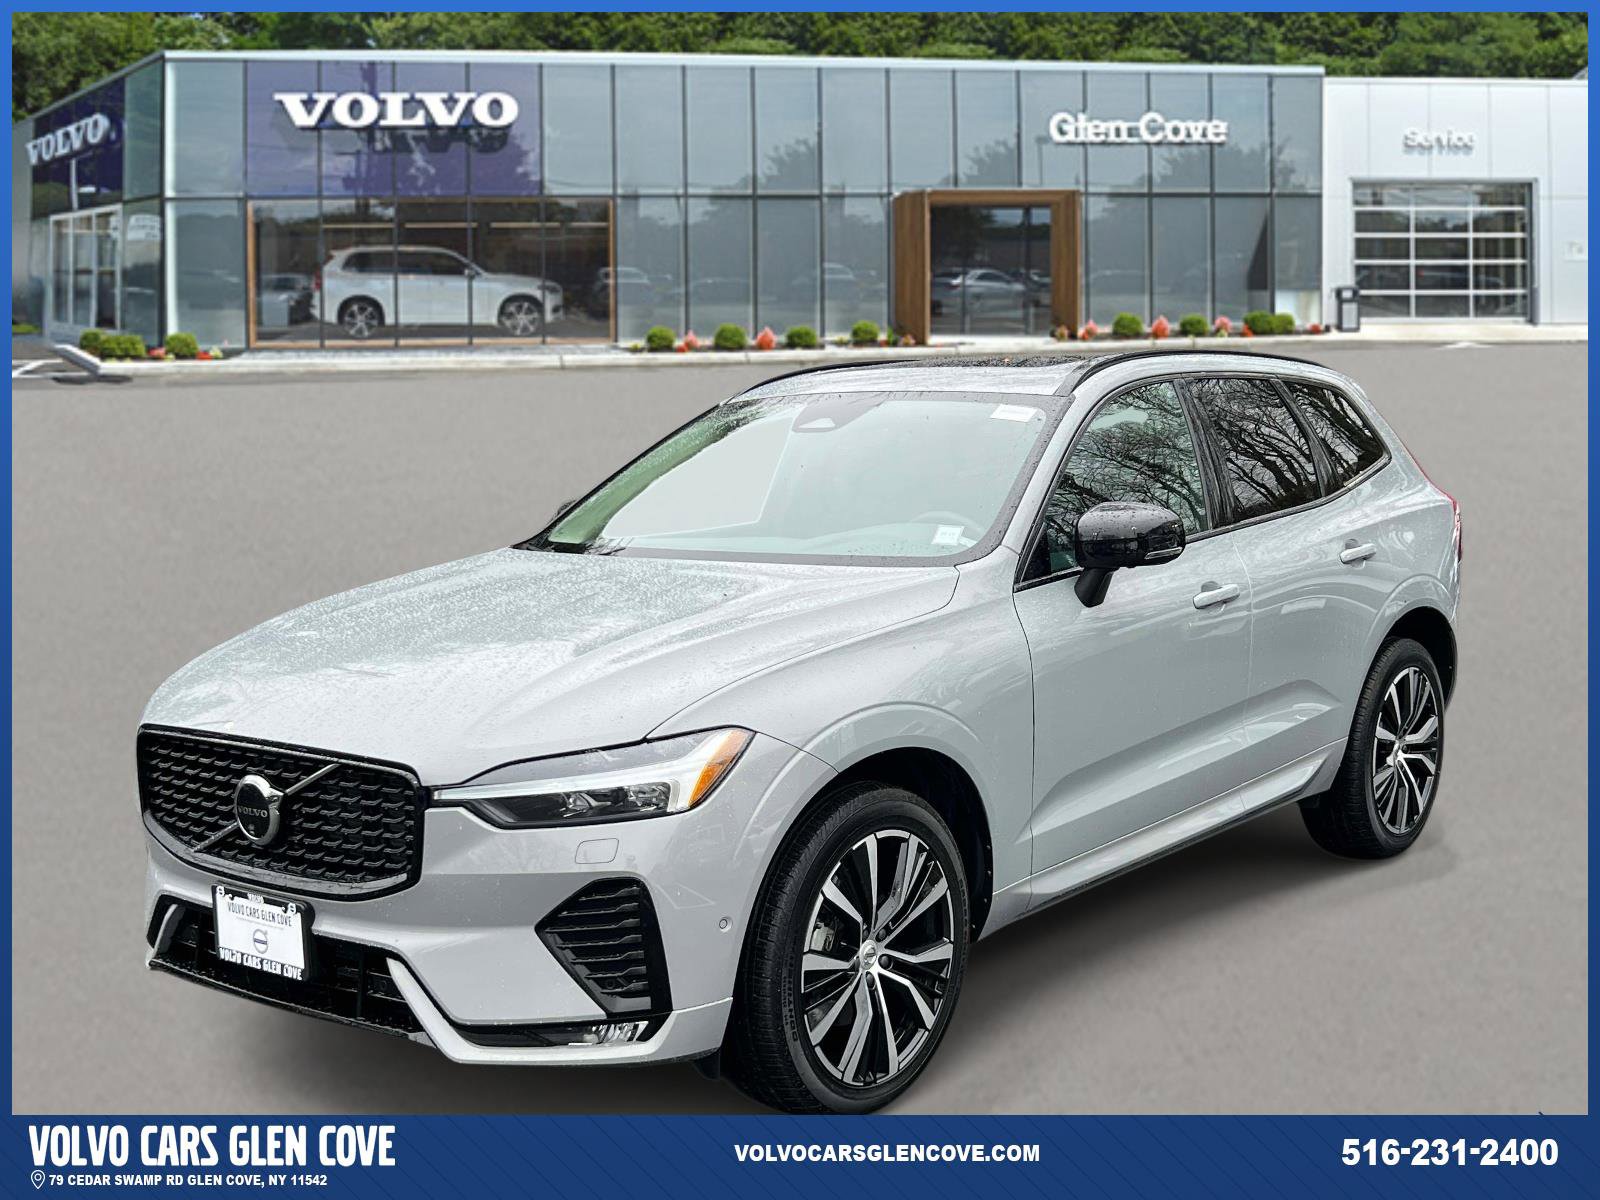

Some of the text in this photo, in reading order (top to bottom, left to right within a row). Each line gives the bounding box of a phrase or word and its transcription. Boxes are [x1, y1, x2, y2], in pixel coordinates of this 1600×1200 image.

[275, 92, 519, 128] VOLVO
[25, 112, 111, 166] VOLVO
[1050, 112, 1228, 143] Glen Cove
[1403, 128, 1475, 155] Service
[240, 805, 268, 818] VOLVO
[245, 905, 260, 919] CARS
[261, 909, 276, 923] GLEN
[219, 947, 303, 981] VOLVO CARS GLEN COVE
